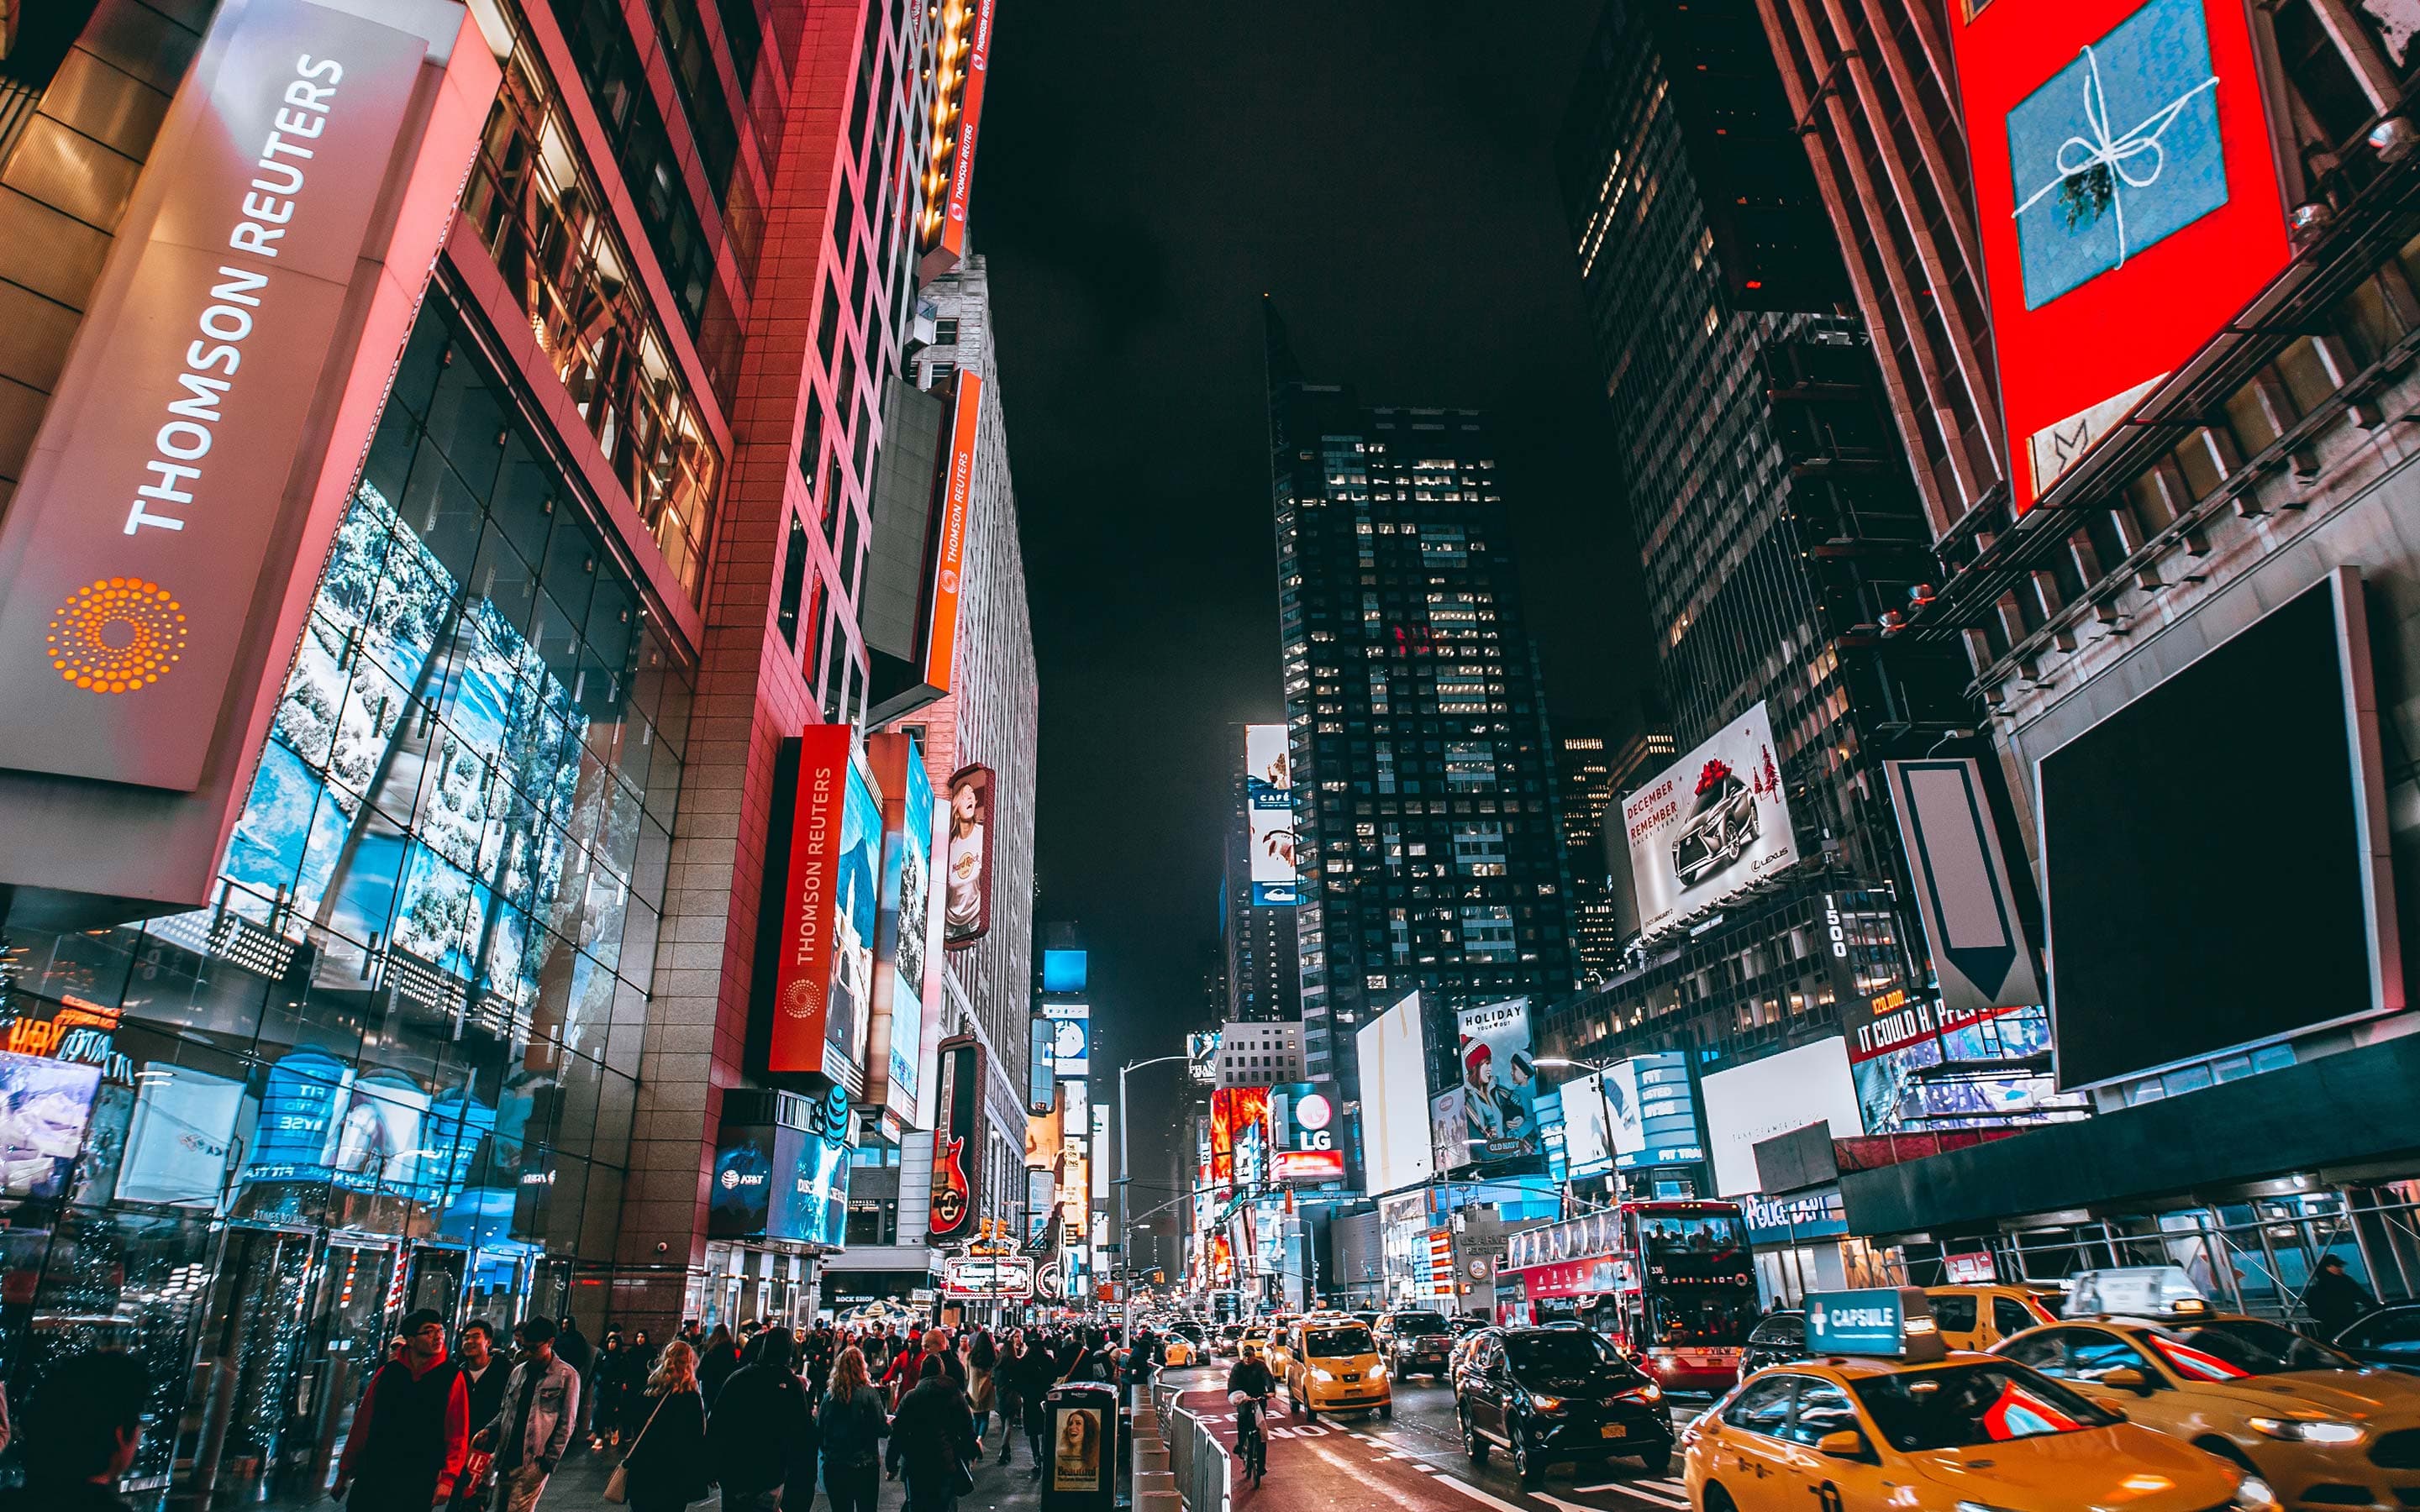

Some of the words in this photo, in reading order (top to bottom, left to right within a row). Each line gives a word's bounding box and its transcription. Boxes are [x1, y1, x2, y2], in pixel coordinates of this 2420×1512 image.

[976, 13, 988, 53] THOMSON
[955, 158, 968, 200] THOMSON
[962, 123, 973, 158] REUTERS
[124, 265, 269, 538] THOMSON
[229, 54, 345, 258] REUTERS
[954, 451, 968, 504] REUTERS
[947, 505, 962, 563] THOMSON
[808, 766, 832, 856] REUTERS
[1260, 791, 1290, 801] CAFÉ
[1627, 780, 1673, 820] DECEMBER
[1630, 801, 1677, 840] REMEMBER
[1633, 831, 1653, 848] SALES
[1657, 814, 1679, 832] EVENT
[1760, 847, 1789, 866] LEXUS
[797, 859, 823, 966] THOMSON
[1824, 894, 1847, 958] 1500
[1465, 1006, 1522, 1027] HOLIDAY
[1857, 1025, 1871, 1053] IT
[1872, 1009, 1918, 1048] COULD
[1300, 1131, 1332, 1151] LG
[1489, 1142, 1502, 1152] OLD
[1502, 1140, 1519, 1151] NAVY
[740, 1174, 764, 1185] AT&T
[1746, 1194, 1789, 1231] POLICE
[1650, 1266, 1663, 1274] 336
[1831, 1306, 1894, 1329] CAPSULE
